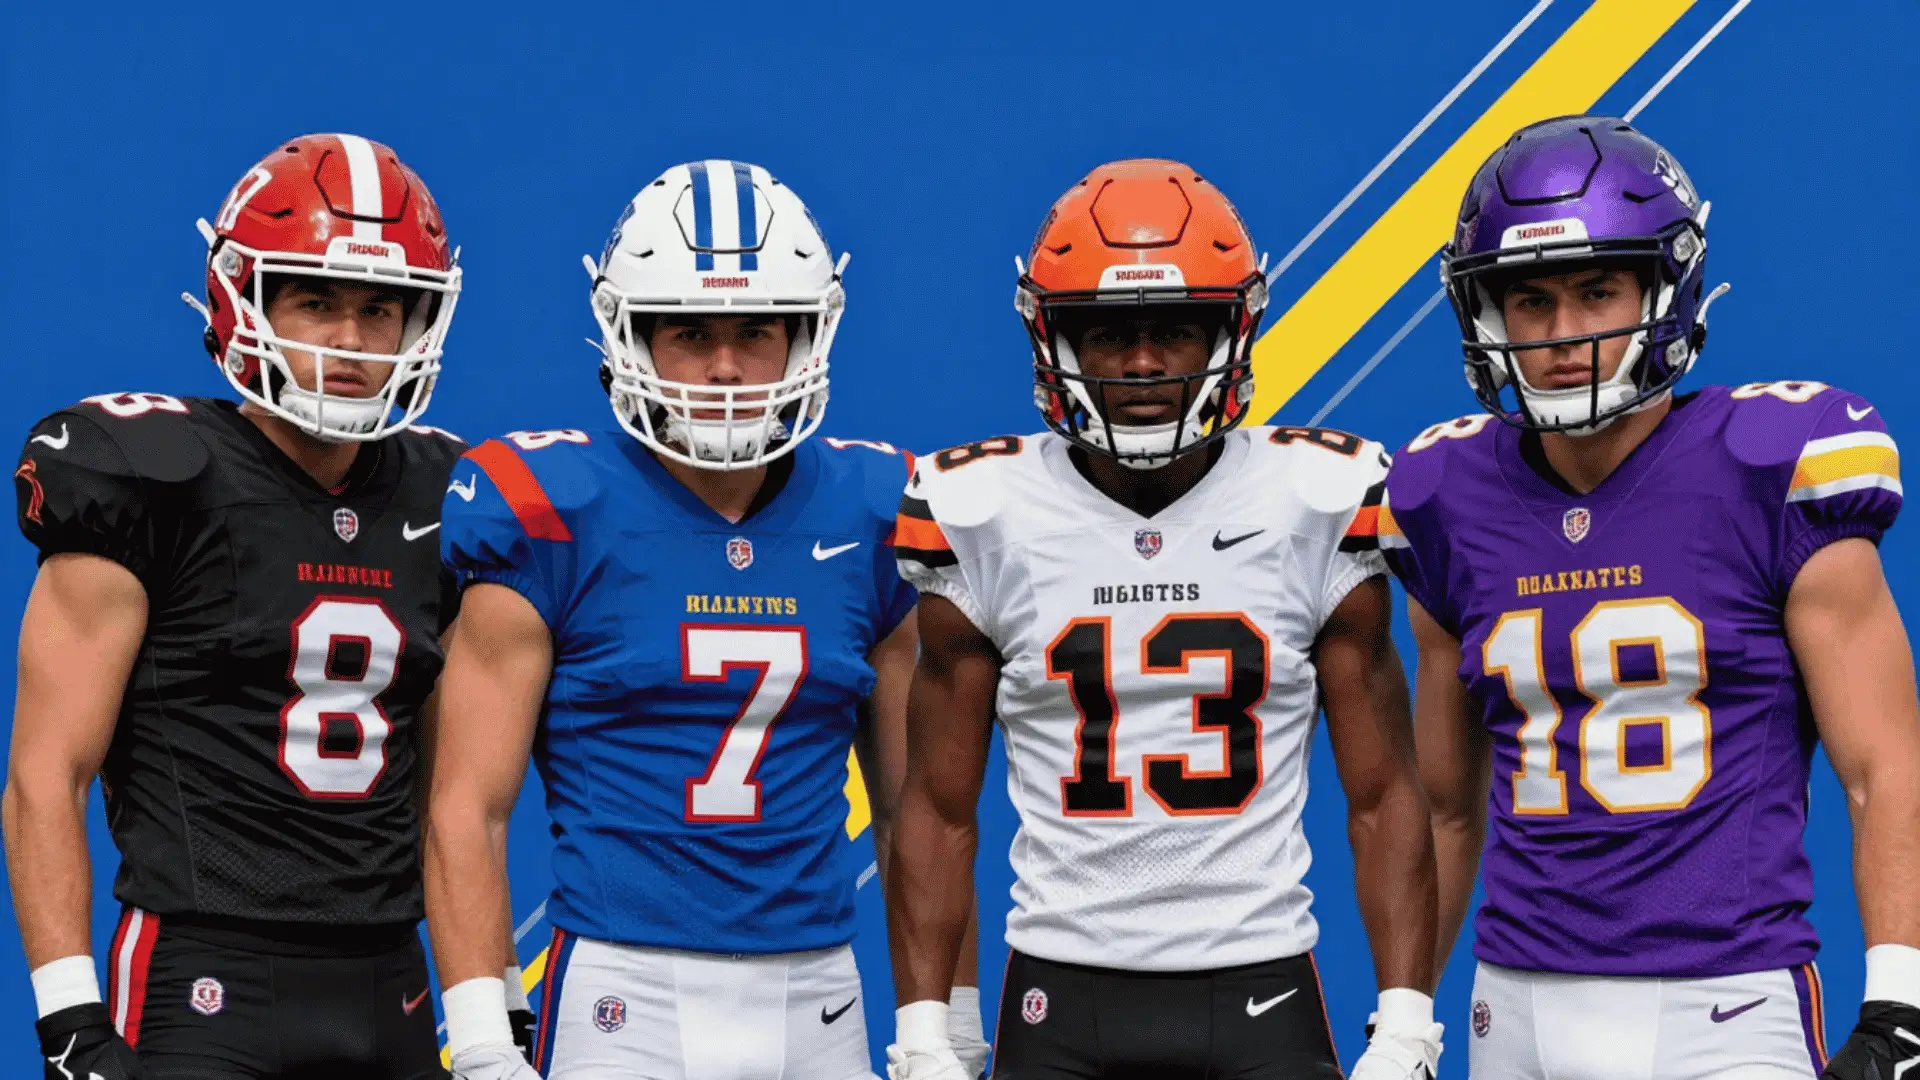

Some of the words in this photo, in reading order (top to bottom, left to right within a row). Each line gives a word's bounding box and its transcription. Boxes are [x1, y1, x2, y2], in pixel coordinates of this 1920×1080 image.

[280, 595, 406, 797] 8
[680, 621, 809, 823] 7
[1044, 611, 1271, 817] 13
[1482, 597, 1711, 815] 18
